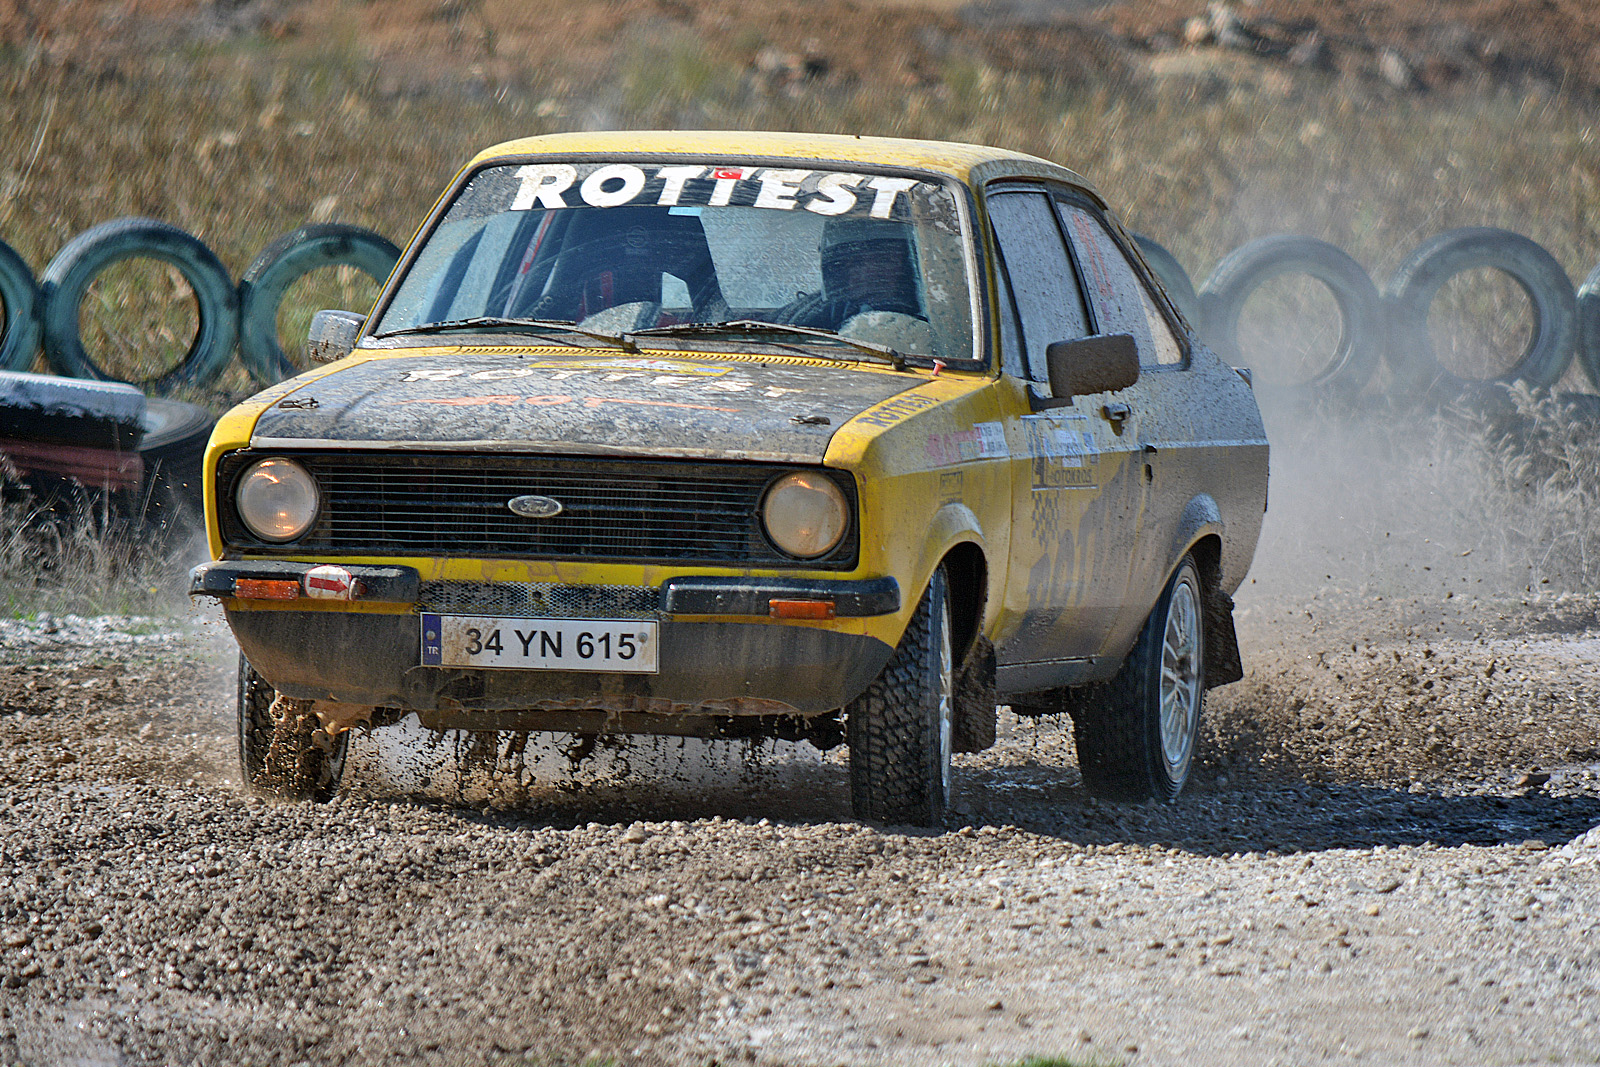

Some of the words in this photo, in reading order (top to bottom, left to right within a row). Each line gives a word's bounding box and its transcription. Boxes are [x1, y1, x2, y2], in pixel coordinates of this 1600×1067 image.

[509, 163, 921, 219] ROTTEST
[402, 368, 804, 398] ROTTEST
[855, 393, 940, 428] ROTTEST
[520, 500, 549, 513] Ford
[427, 645, 439, 655] TR
[464, 628, 504, 656] 34
[513, 629, 563, 658] YN
[576, 631, 637, 660] 615
